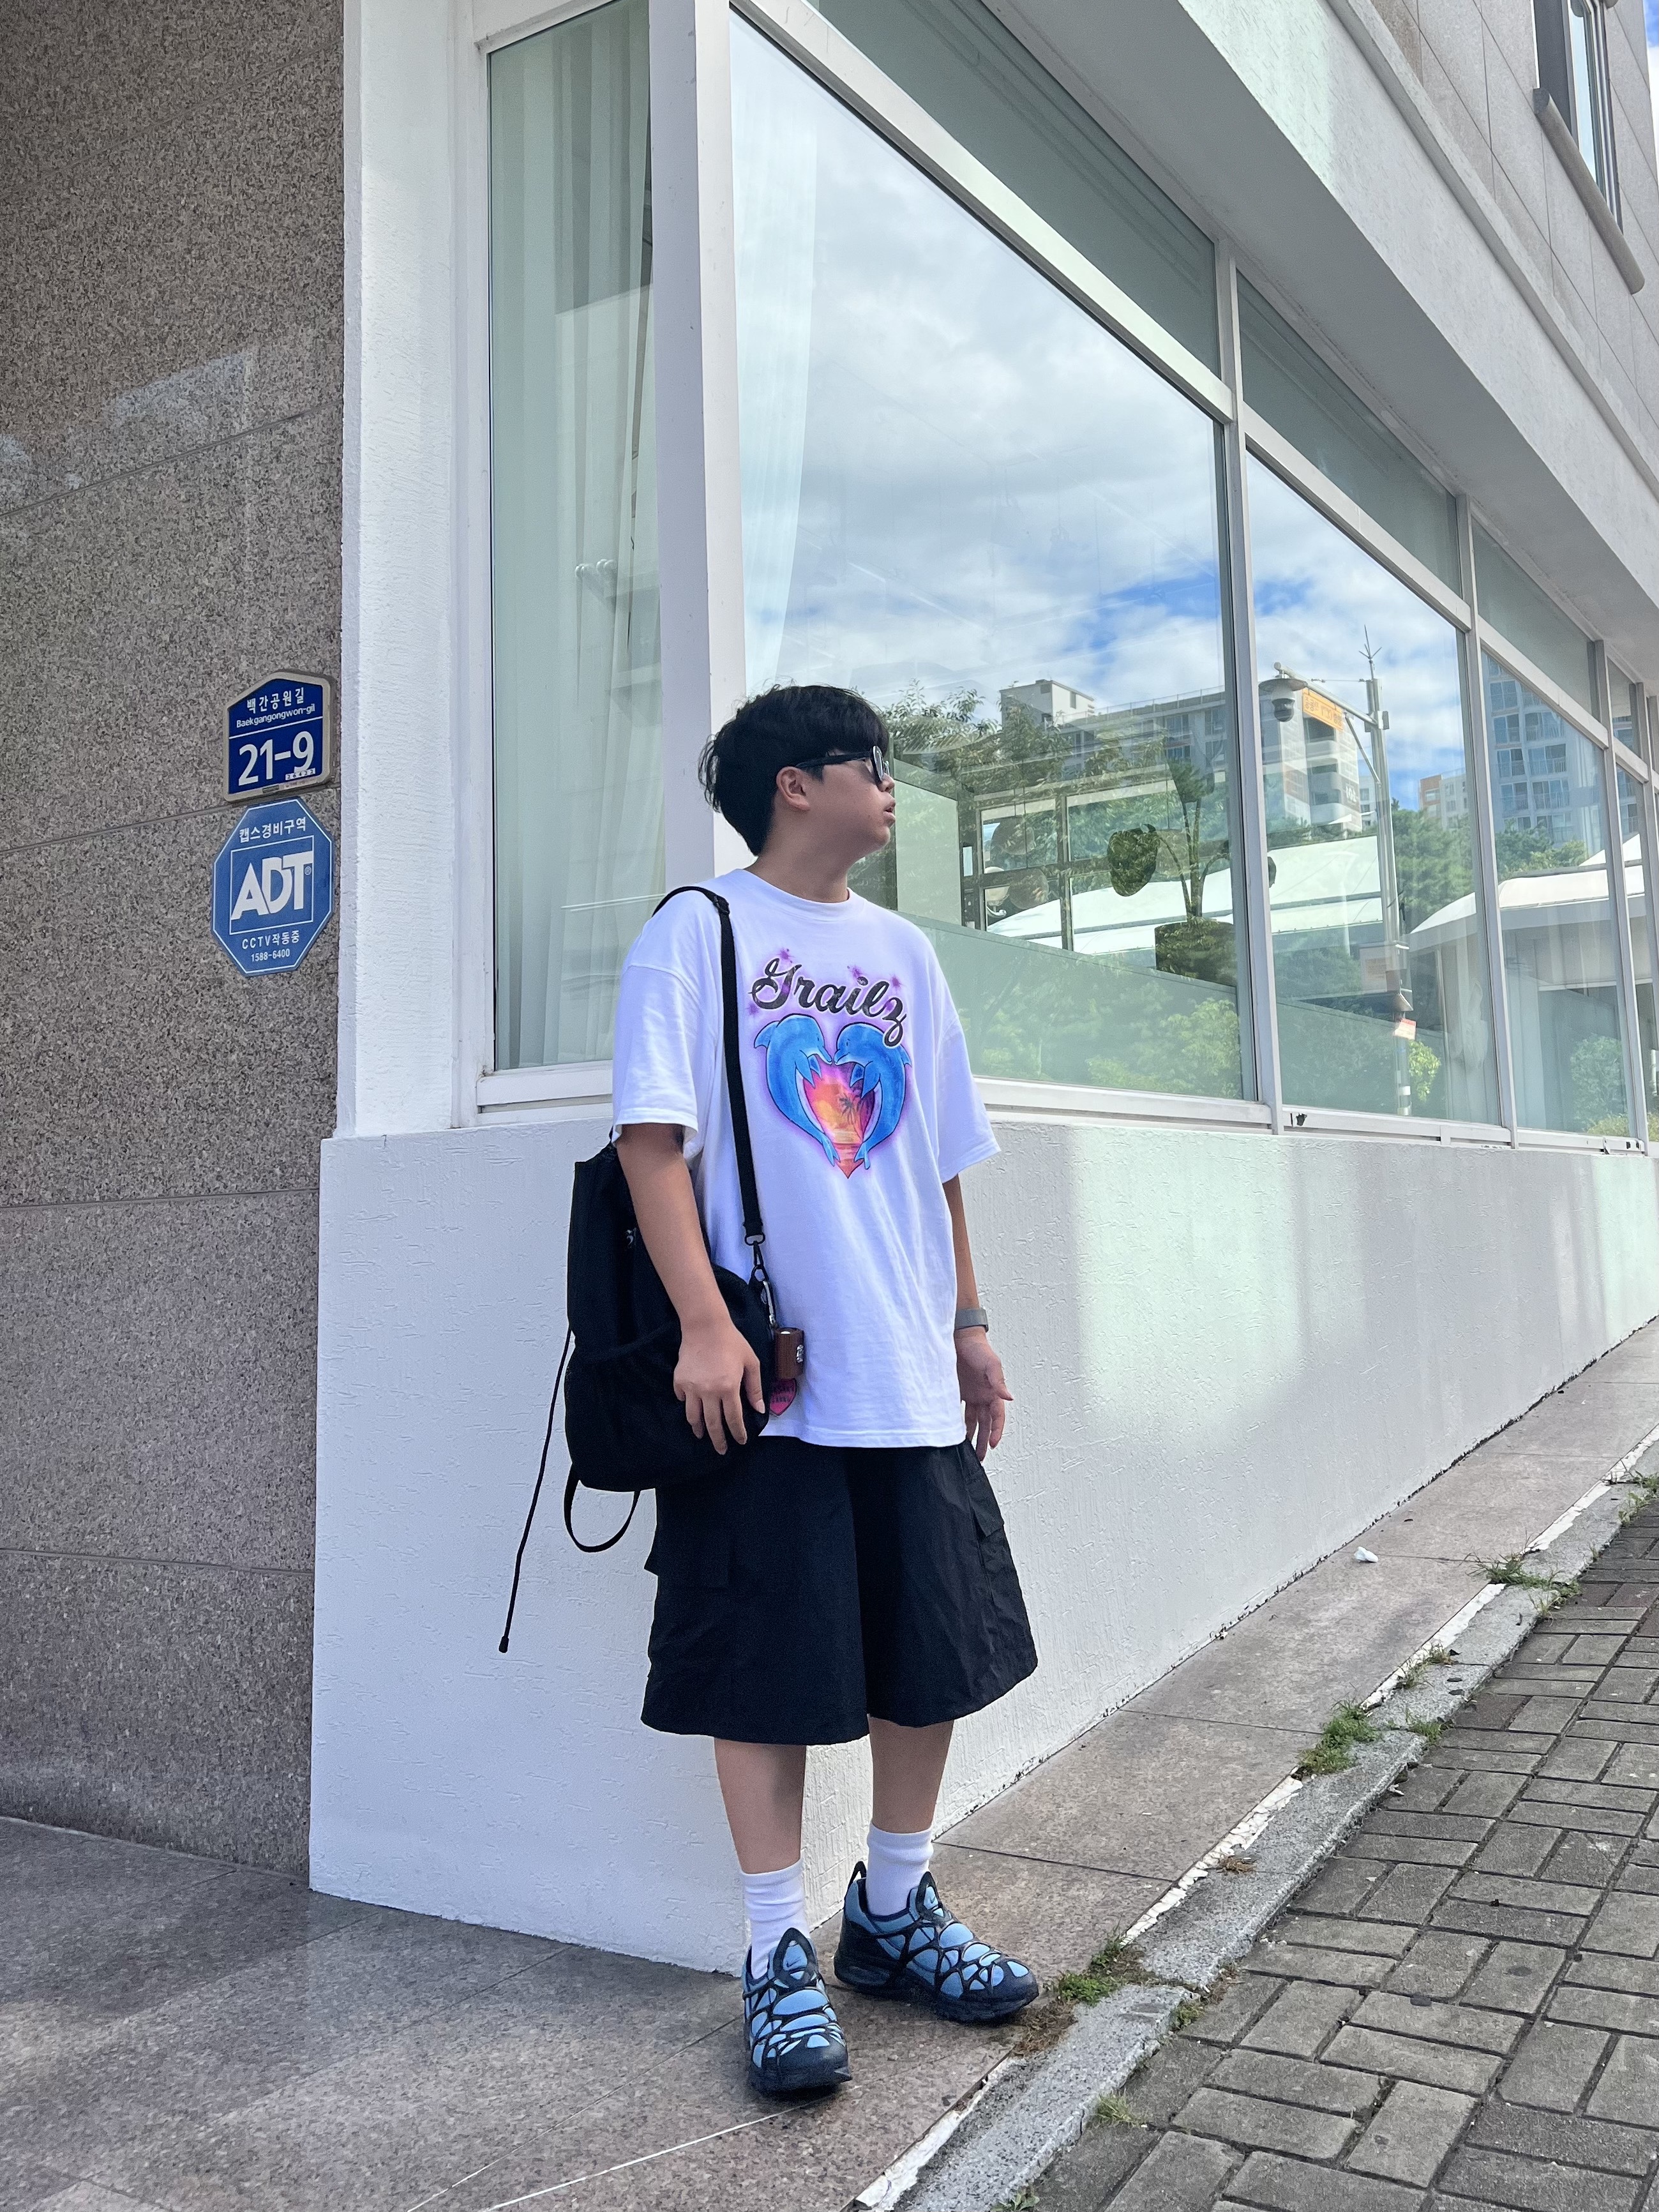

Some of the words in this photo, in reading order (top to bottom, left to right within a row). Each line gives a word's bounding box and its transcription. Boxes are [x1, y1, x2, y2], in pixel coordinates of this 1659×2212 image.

[247, 688, 304, 714] 백간공원길
[236, 703, 315, 728] Baekgangongwon-gil
[238, 731, 314, 786] 21-9
[239, 816, 307, 843] 캡스경비구역
[230, 850, 314, 921] ADT
[251, 949, 290, 962] 1588-6400
[748, 957, 908, 1048] Grailz
